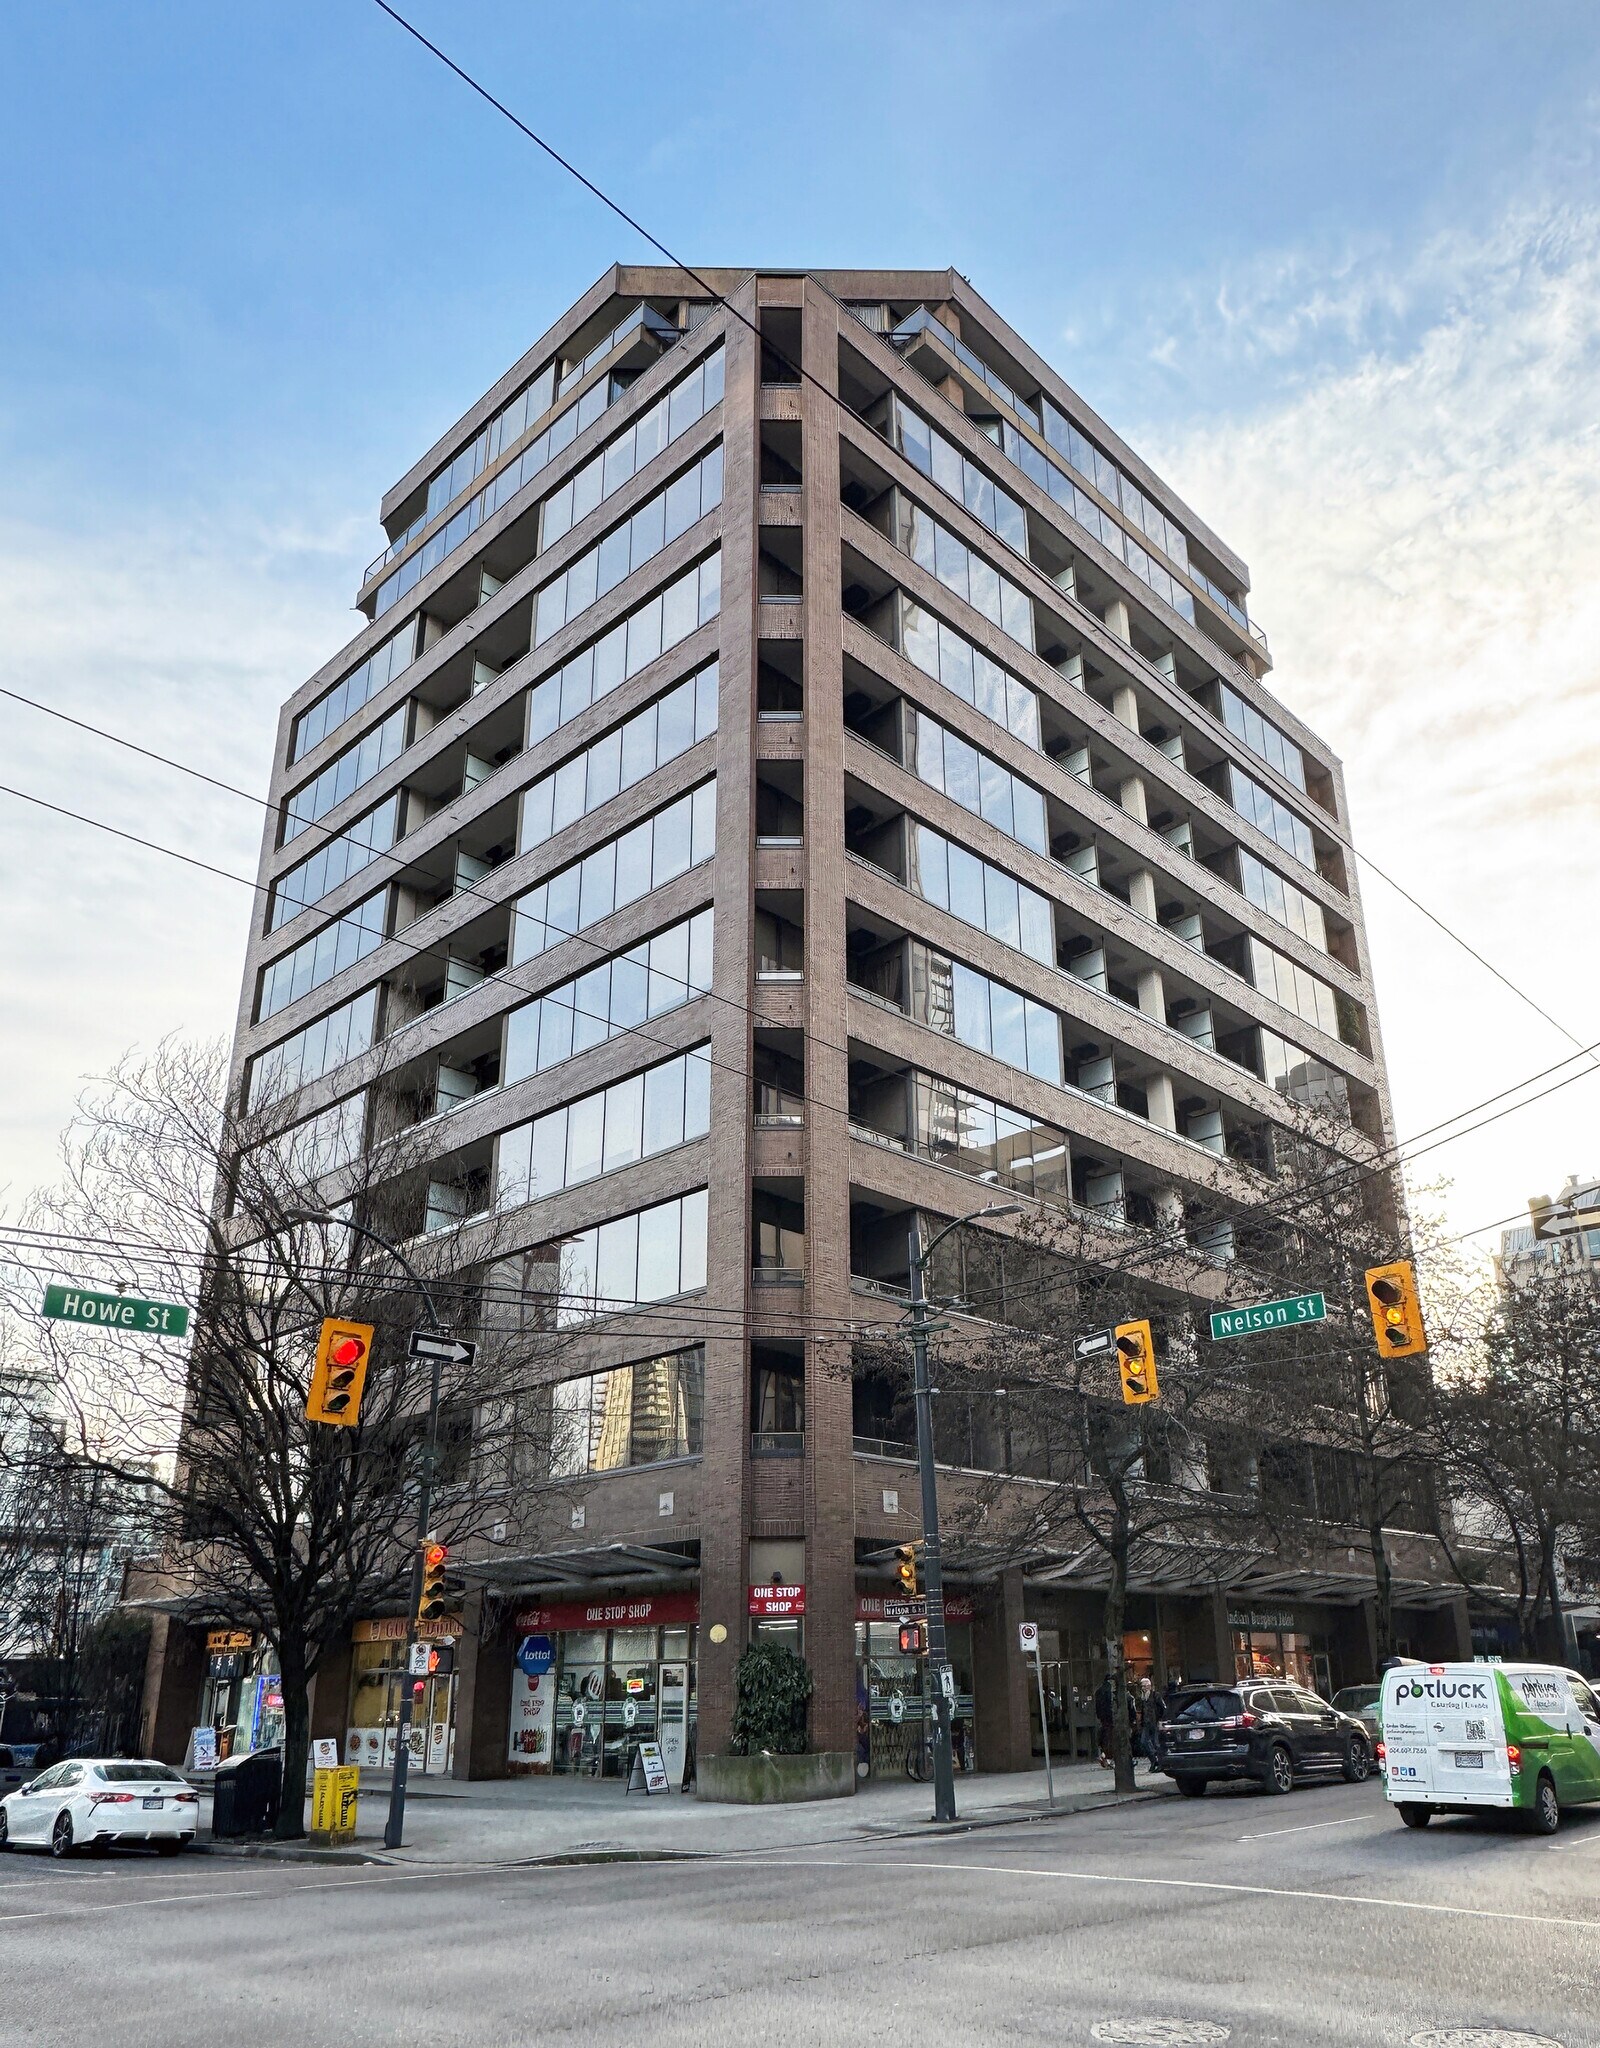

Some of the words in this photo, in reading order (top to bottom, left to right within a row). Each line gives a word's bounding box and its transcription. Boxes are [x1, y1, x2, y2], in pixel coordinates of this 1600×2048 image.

[63, 1293, 135, 1324] Howe
[145, 1307, 171, 1330] St
[1220, 1307, 1287, 1333] Nelson
[1297, 1299, 1316, 1318] St
[754, 1587, 774, 1598] ONE
[776, 1587, 801, 1598] STOP
[586, 1607, 604, 1621] ONE
[605, 1606, 626, 1620] STOP
[628, 1603, 652, 1618] SHOP
[765, 1601, 792, 1612] SHOP
[861, 1598, 880, 1612] ONE
[525, 1650, 551, 1660] Lotto!
[1396, 1678, 1488, 1706] potluck
